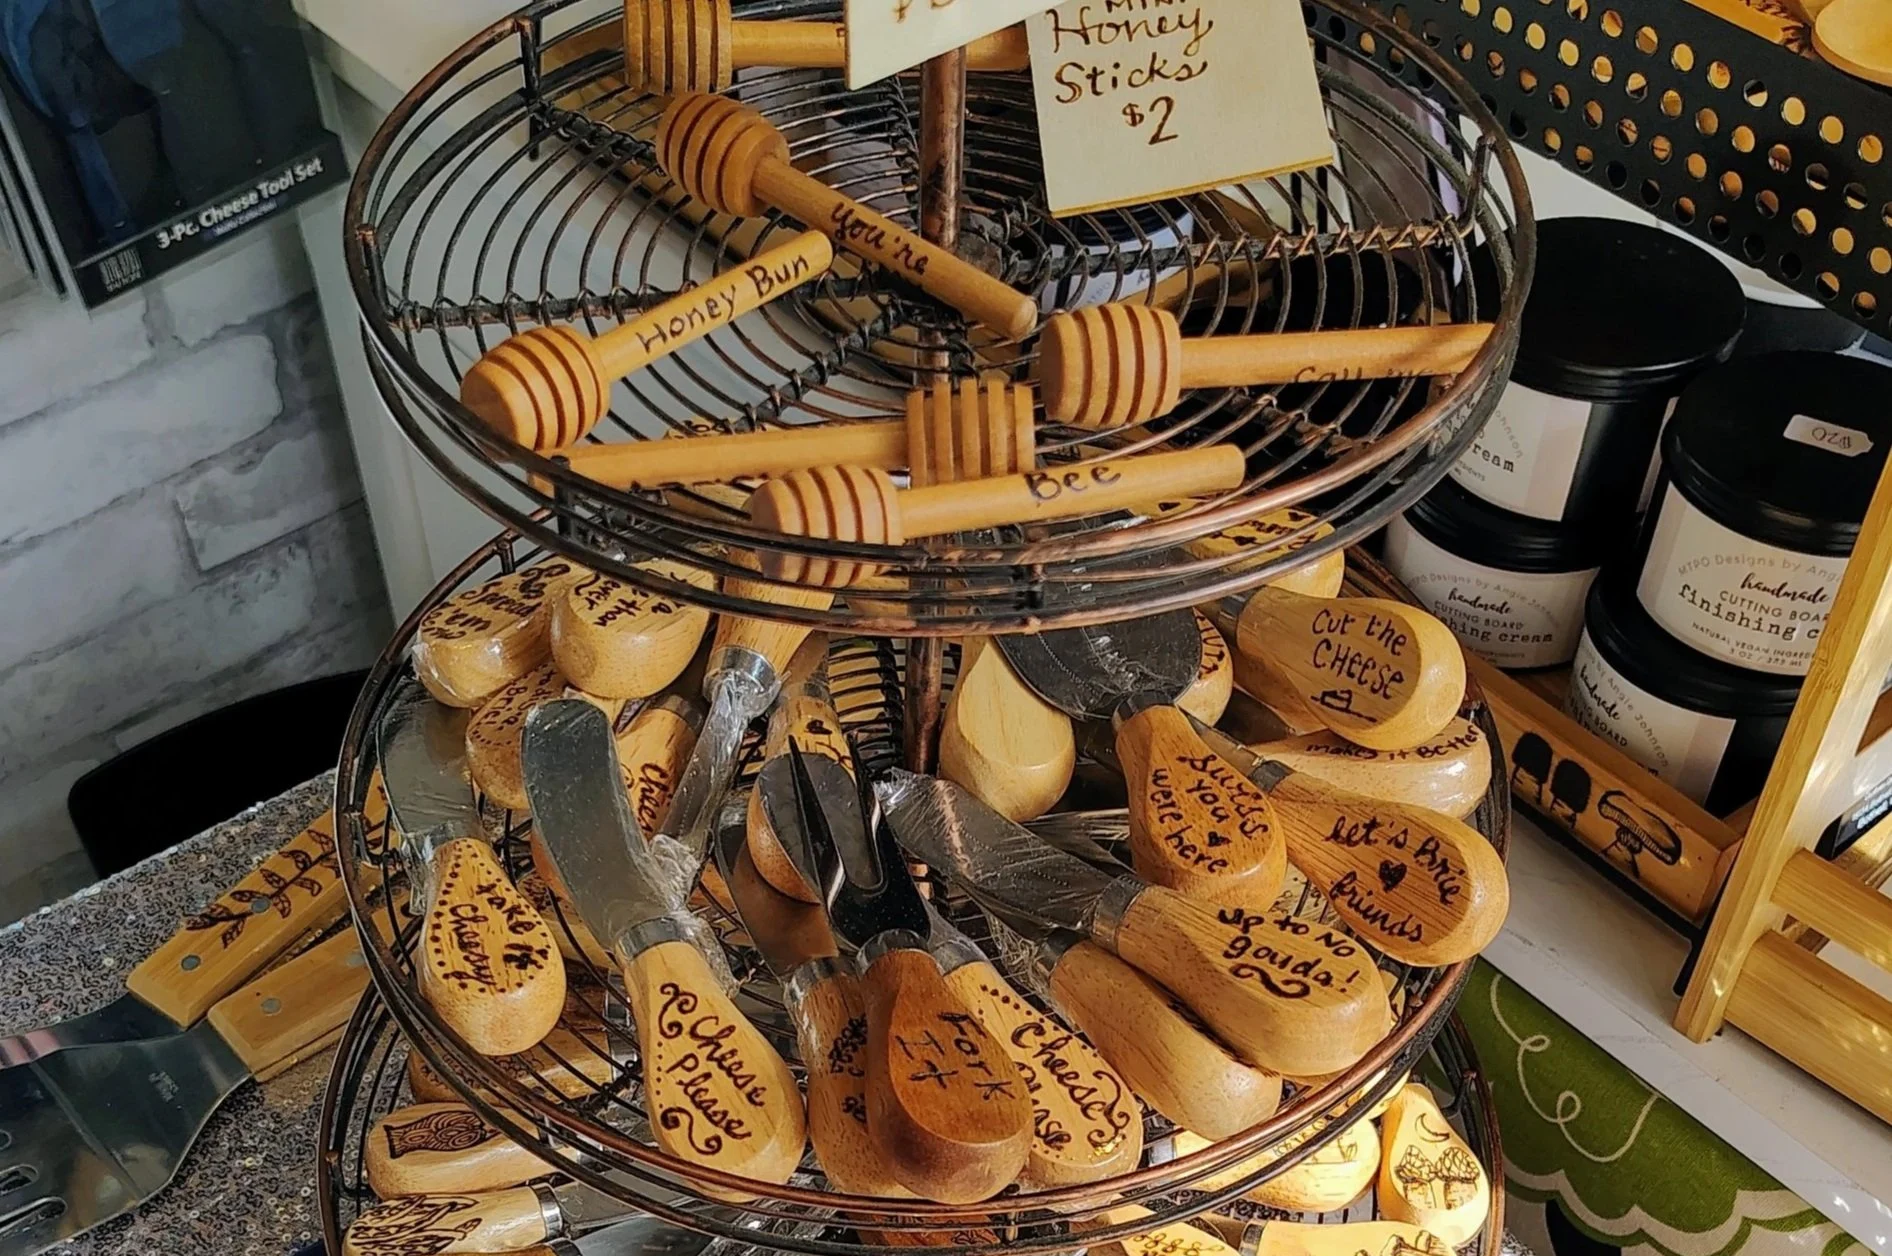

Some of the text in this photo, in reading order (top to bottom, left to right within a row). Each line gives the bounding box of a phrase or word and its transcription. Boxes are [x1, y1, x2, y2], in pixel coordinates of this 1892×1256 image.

[1046, 6, 1214, 57] Honey
[1054, 51, 1208, 104] Sticks
[1122, 95, 1179, 145] $2
[199, 191, 259, 228] Cheese
[257, 170, 295, 199] Tool
[293, 157, 324, 183] Set
[636, 254, 810, 354] Honey Bun
[1471, 442, 1515, 473] ream
[1023, 464, 1123, 502] Bee
[1715, 553, 1776, 569] Designs
[1781, 558, 1802, 573] by
[1448, 587, 1514, 615] handmade
[1718, 590, 1783, 619] CUTTING
[1740, 571, 1830, 605] handmade
[1311, 608, 1408, 657] Cut the
[1434, 600, 1525, 632] CUTTING BOARD
[1677, 583, 1797, 642] finishing
[1498, 630, 1554, 644] cream
[1151, 768, 1229, 875] were here
[1185, 778, 1229, 825] you
[1273, 914, 1309, 936] to
